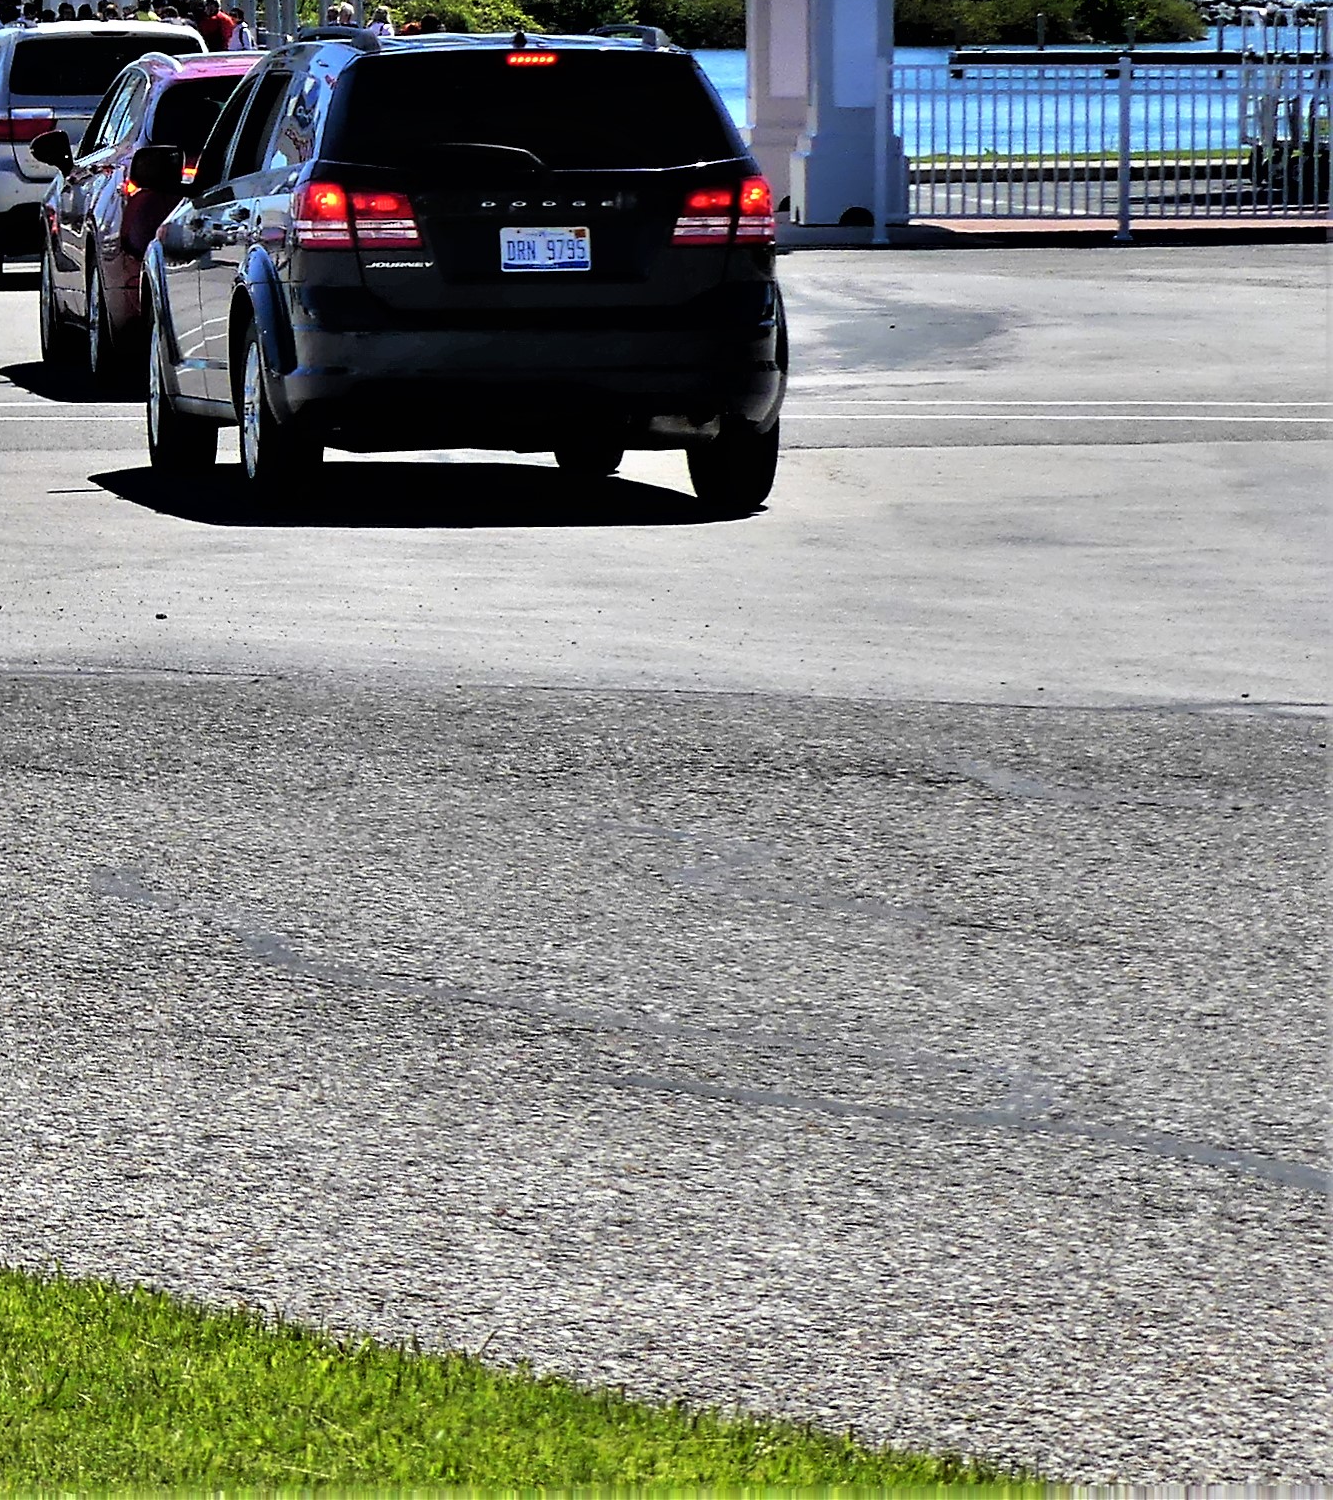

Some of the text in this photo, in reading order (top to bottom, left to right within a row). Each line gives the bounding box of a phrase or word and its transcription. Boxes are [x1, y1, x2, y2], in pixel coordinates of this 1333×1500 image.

[507, 239, 587, 261] DRN 9795
[365, 261, 434, 269] JOURNEY
